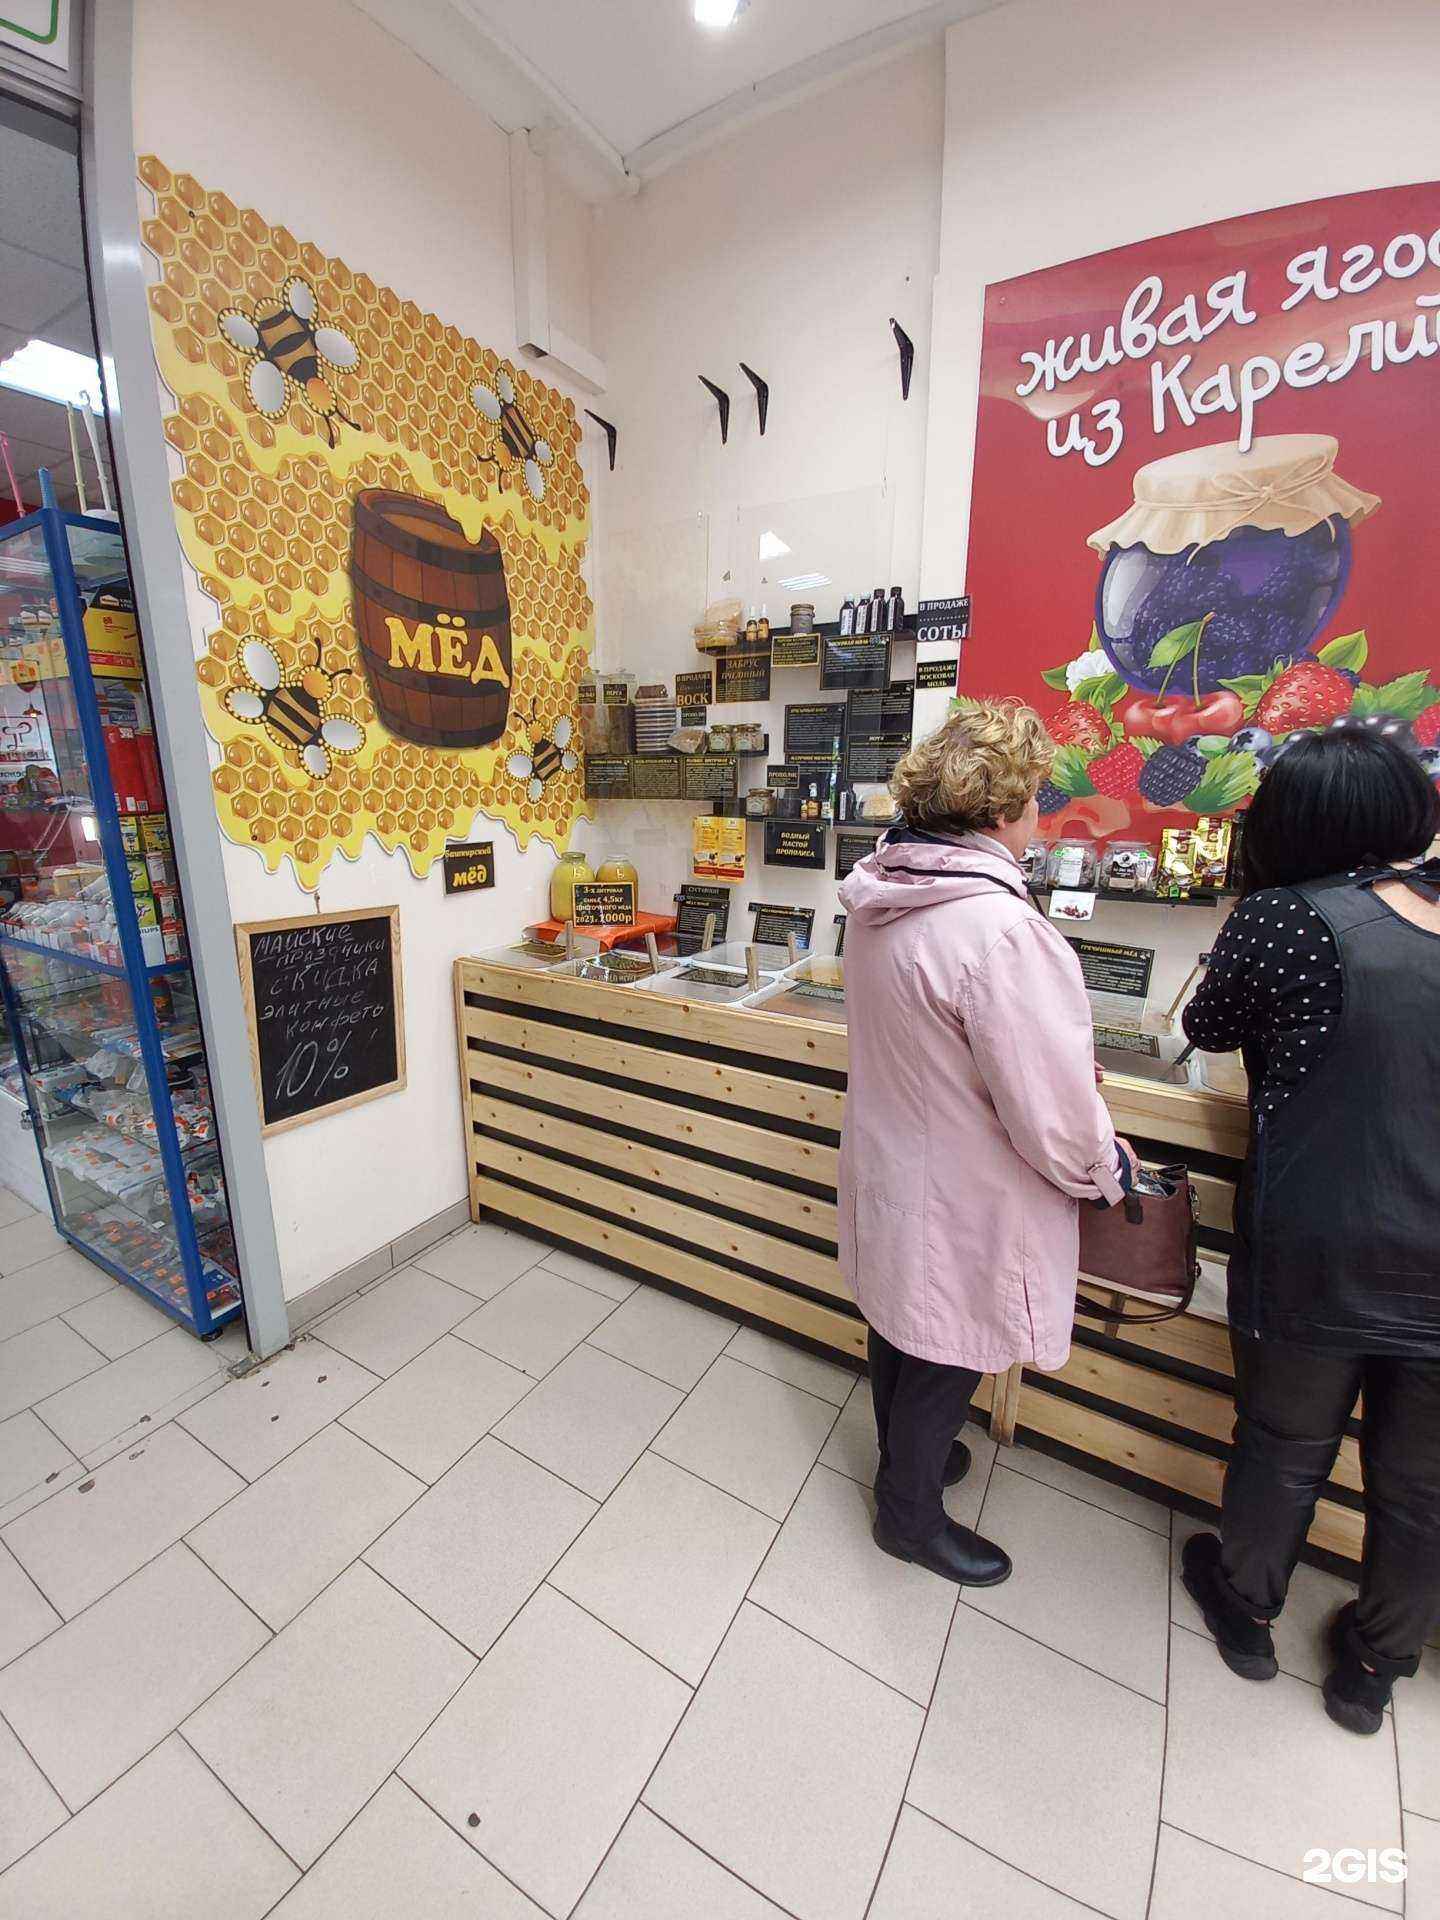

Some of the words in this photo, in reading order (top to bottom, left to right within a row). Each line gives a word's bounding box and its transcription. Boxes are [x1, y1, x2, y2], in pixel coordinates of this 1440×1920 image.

[1015, 270, 1257, 397] живая
[1047, 398, 1125, 467] из
[1150, 310, 1440, 454] Карели
[927, 598, 969, 610] ПРОДАЖЕ
[917, 622, 967, 642] СОТЫ
[384, 613, 511, 689] МЁД
[676, 692, 709, 706] ВОСК
[781, 831, 810, 840] ВОДНЫЙ
[782, 839, 809, 848] НАСТОЙ
[775, 848, 816, 858] ПРОПОЛИСА
[275, 1030, 352, 1100] 10%
